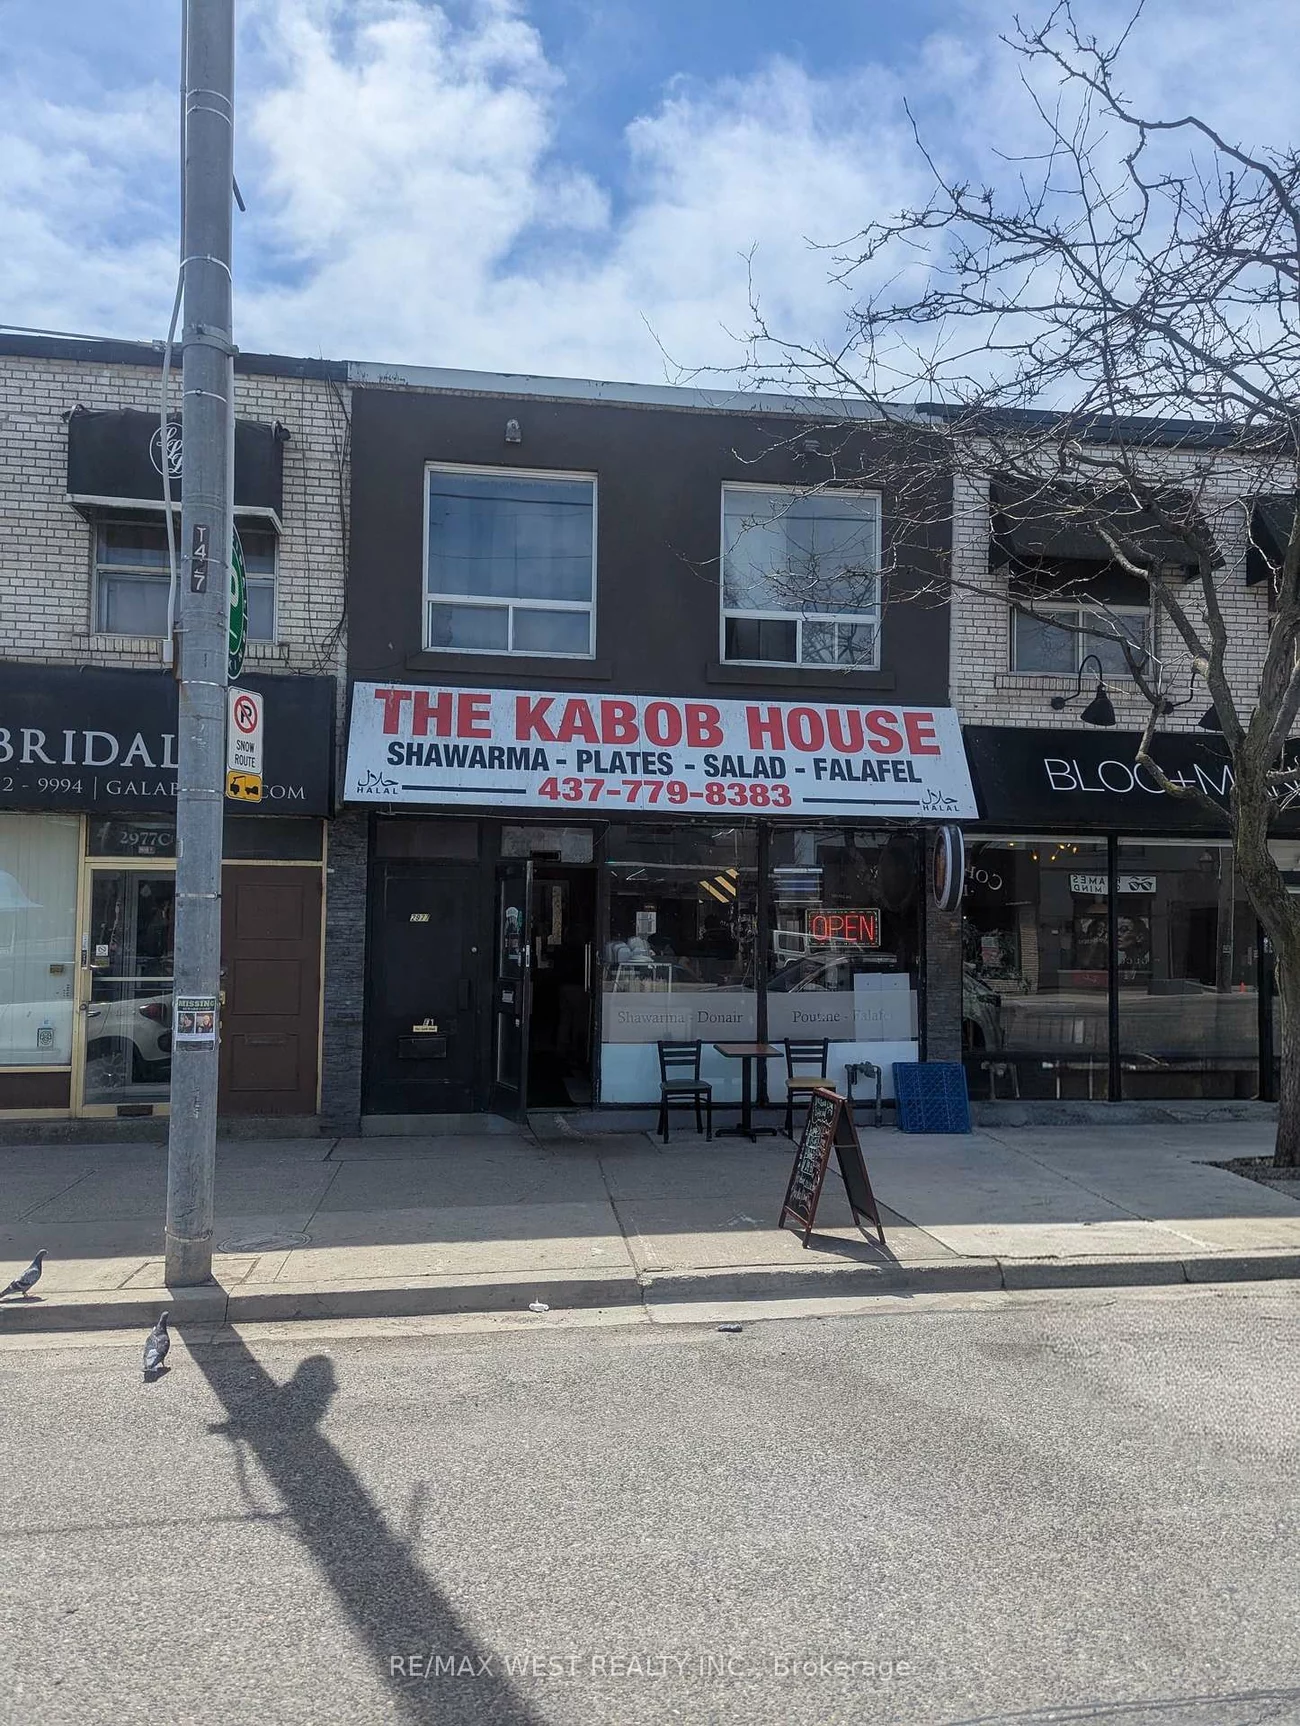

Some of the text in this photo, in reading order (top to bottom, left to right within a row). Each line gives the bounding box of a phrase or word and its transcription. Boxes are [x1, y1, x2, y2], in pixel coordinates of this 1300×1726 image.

[374, 688, 941, 755] THE KABOB HOUSE
[0, 728, 178, 768] BRIDAL
[236, 739, 255, 753] SNOW
[234, 753, 255, 768] ROUTE
[387, 741, 550, 772] SHAWARMA
[576, 749, 674, 776] PLATES
[704, 753, 787, 779] SALAD
[813, 757, 922, 783] FALAFEL
[38, 777, 83, 793] 9994
[356, 786, 399, 795] HALAL
[538, 776, 792, 808] 437-779-8383
[922, 804, 960, 812] HALAL
[812, 915, 874, 941] OPEN
[617, 1010, 686, 1024] Shawarma
[697, 1010, 744, 1023] Donair
